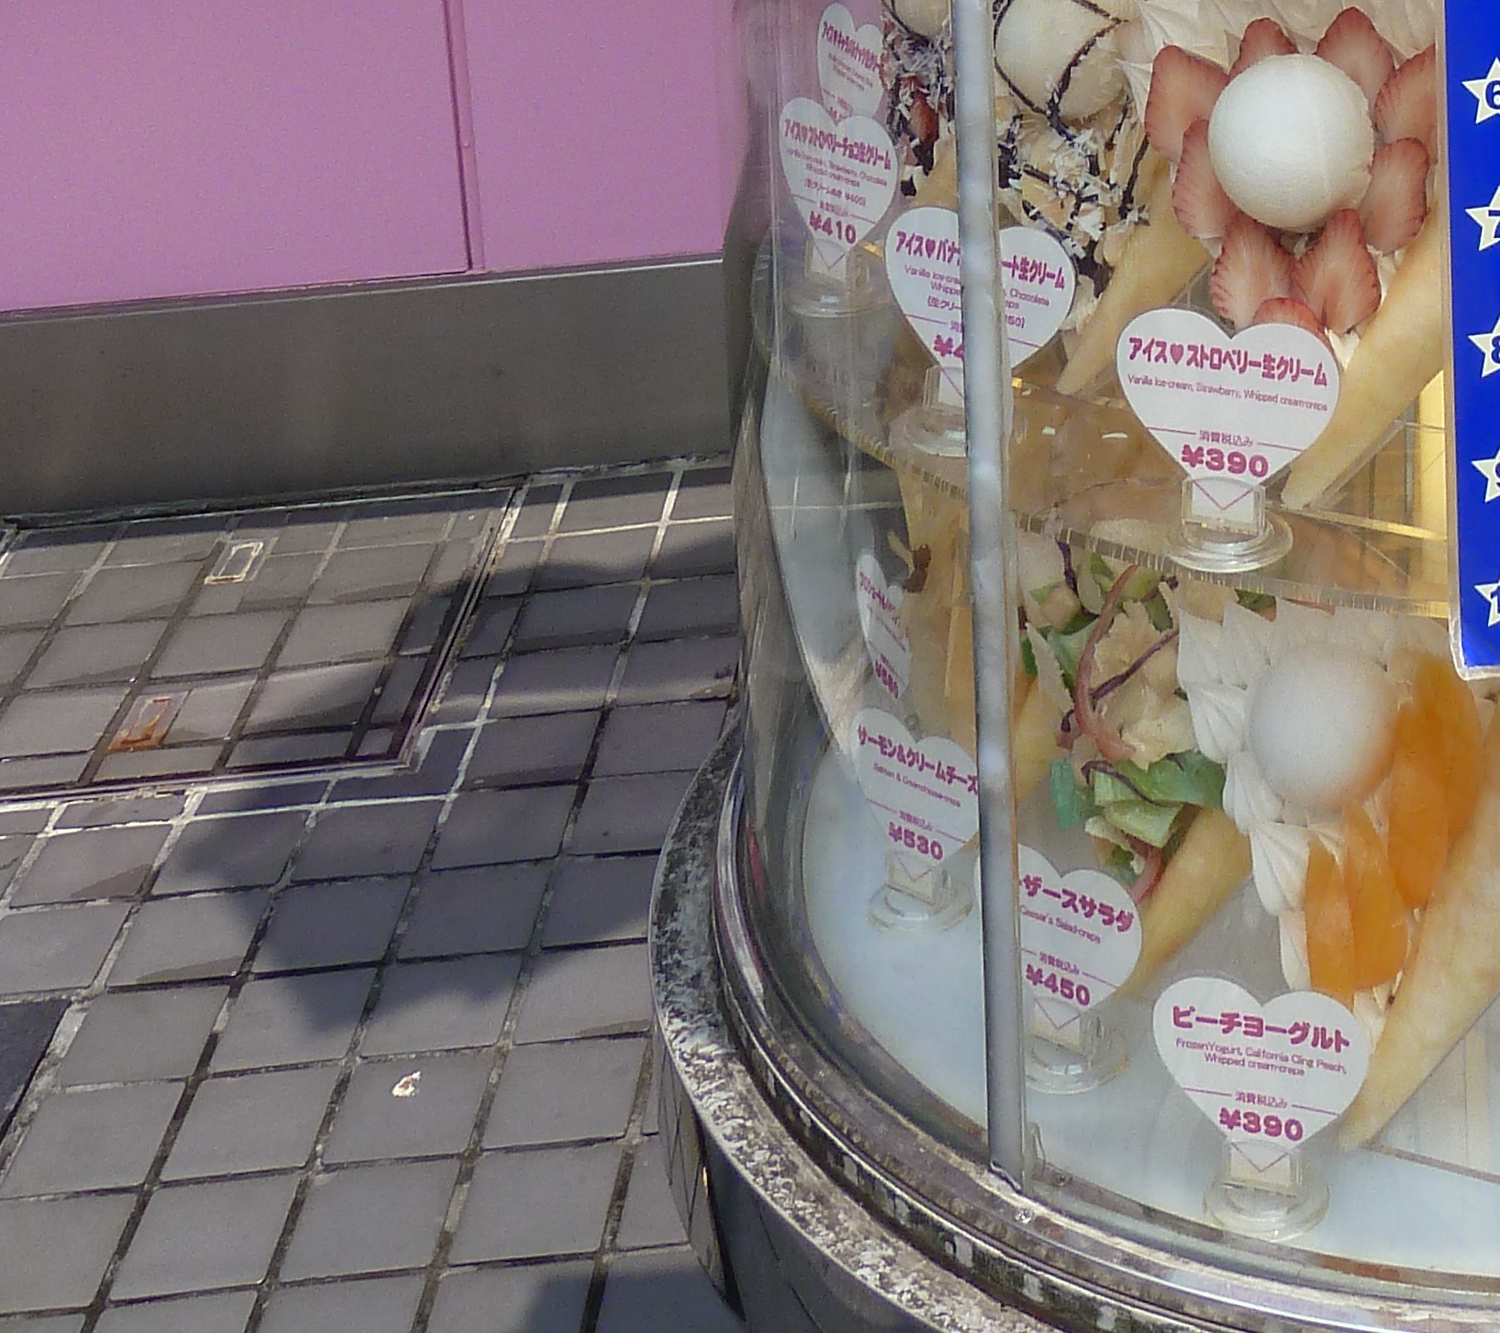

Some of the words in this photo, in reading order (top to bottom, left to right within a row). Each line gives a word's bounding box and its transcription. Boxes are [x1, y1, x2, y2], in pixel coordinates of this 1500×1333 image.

[809, 210, 857, 245] ¥410
[1127, 373, 1154, 387] Vanilla
[1243, 388, 1280, 405] Whipped
[1181, 444, 1269, 479] ¥390
[887, 824, 944, 862] ¥530
[1026, 963, 1091, 1008] ¥450
[1203, 1052, 1246, 1070] Whipped
[1245, 1046, 1289, 1064] California
[1291, 1053, 1314, 1070] Cling
[1218, 1107, 1304, 1142] ¥390
